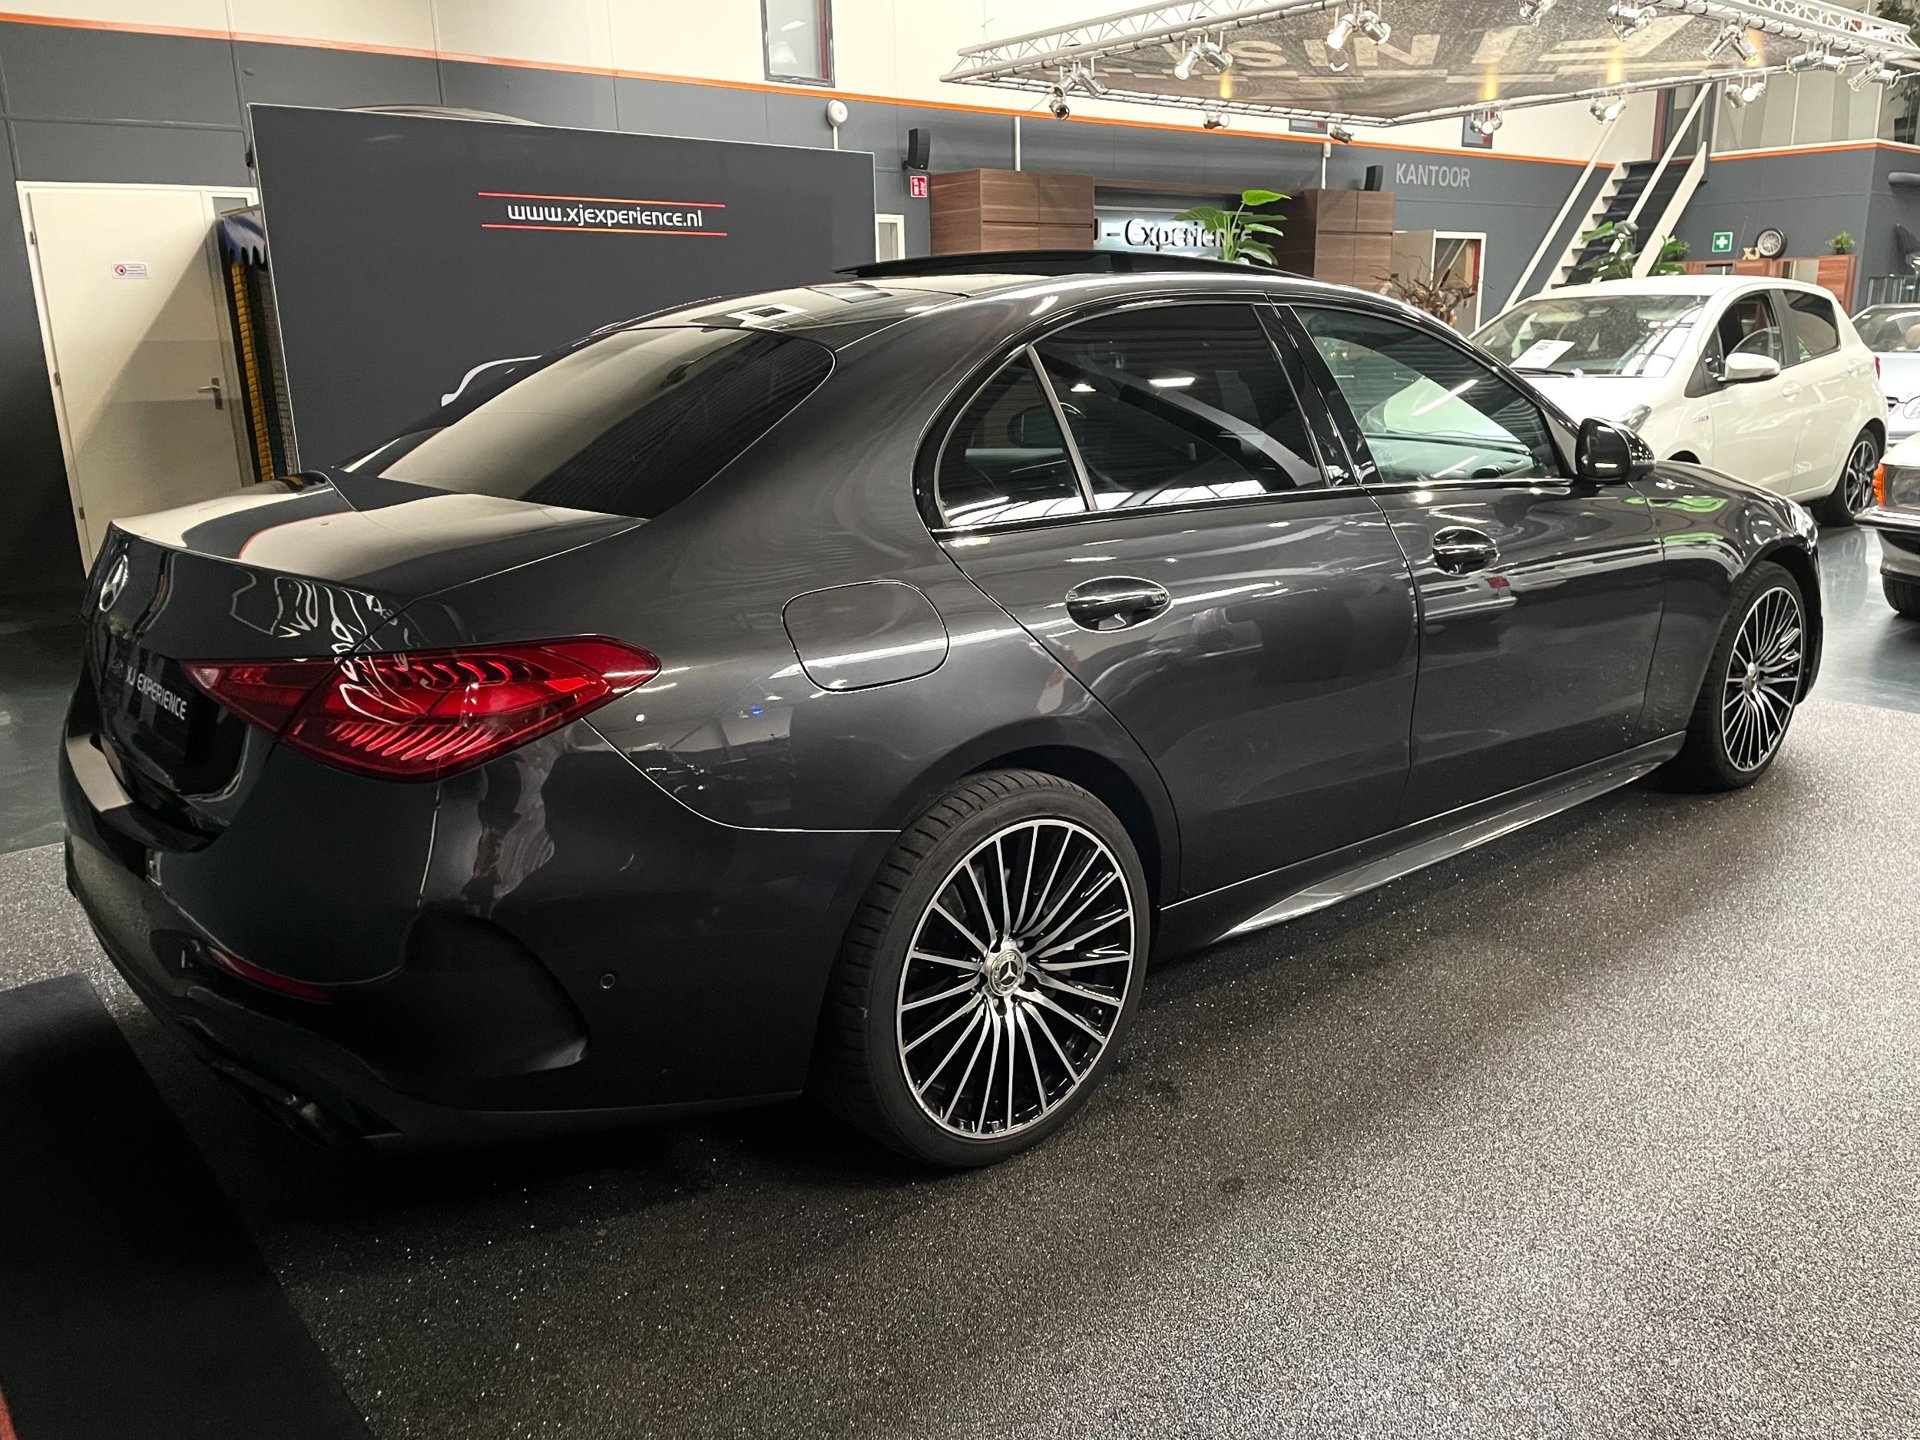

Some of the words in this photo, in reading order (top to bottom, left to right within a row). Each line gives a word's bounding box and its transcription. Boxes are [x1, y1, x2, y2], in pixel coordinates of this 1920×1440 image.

[1163, 14, 1695, 67] FINIS
[1396, 162, 1471, 188] KANTOOR
[507, 204, 703, 228] www.xjexperience.nl
[125, 665, 137, 686] XJ
[136, 672, 187, 721] EXPERIENCE
